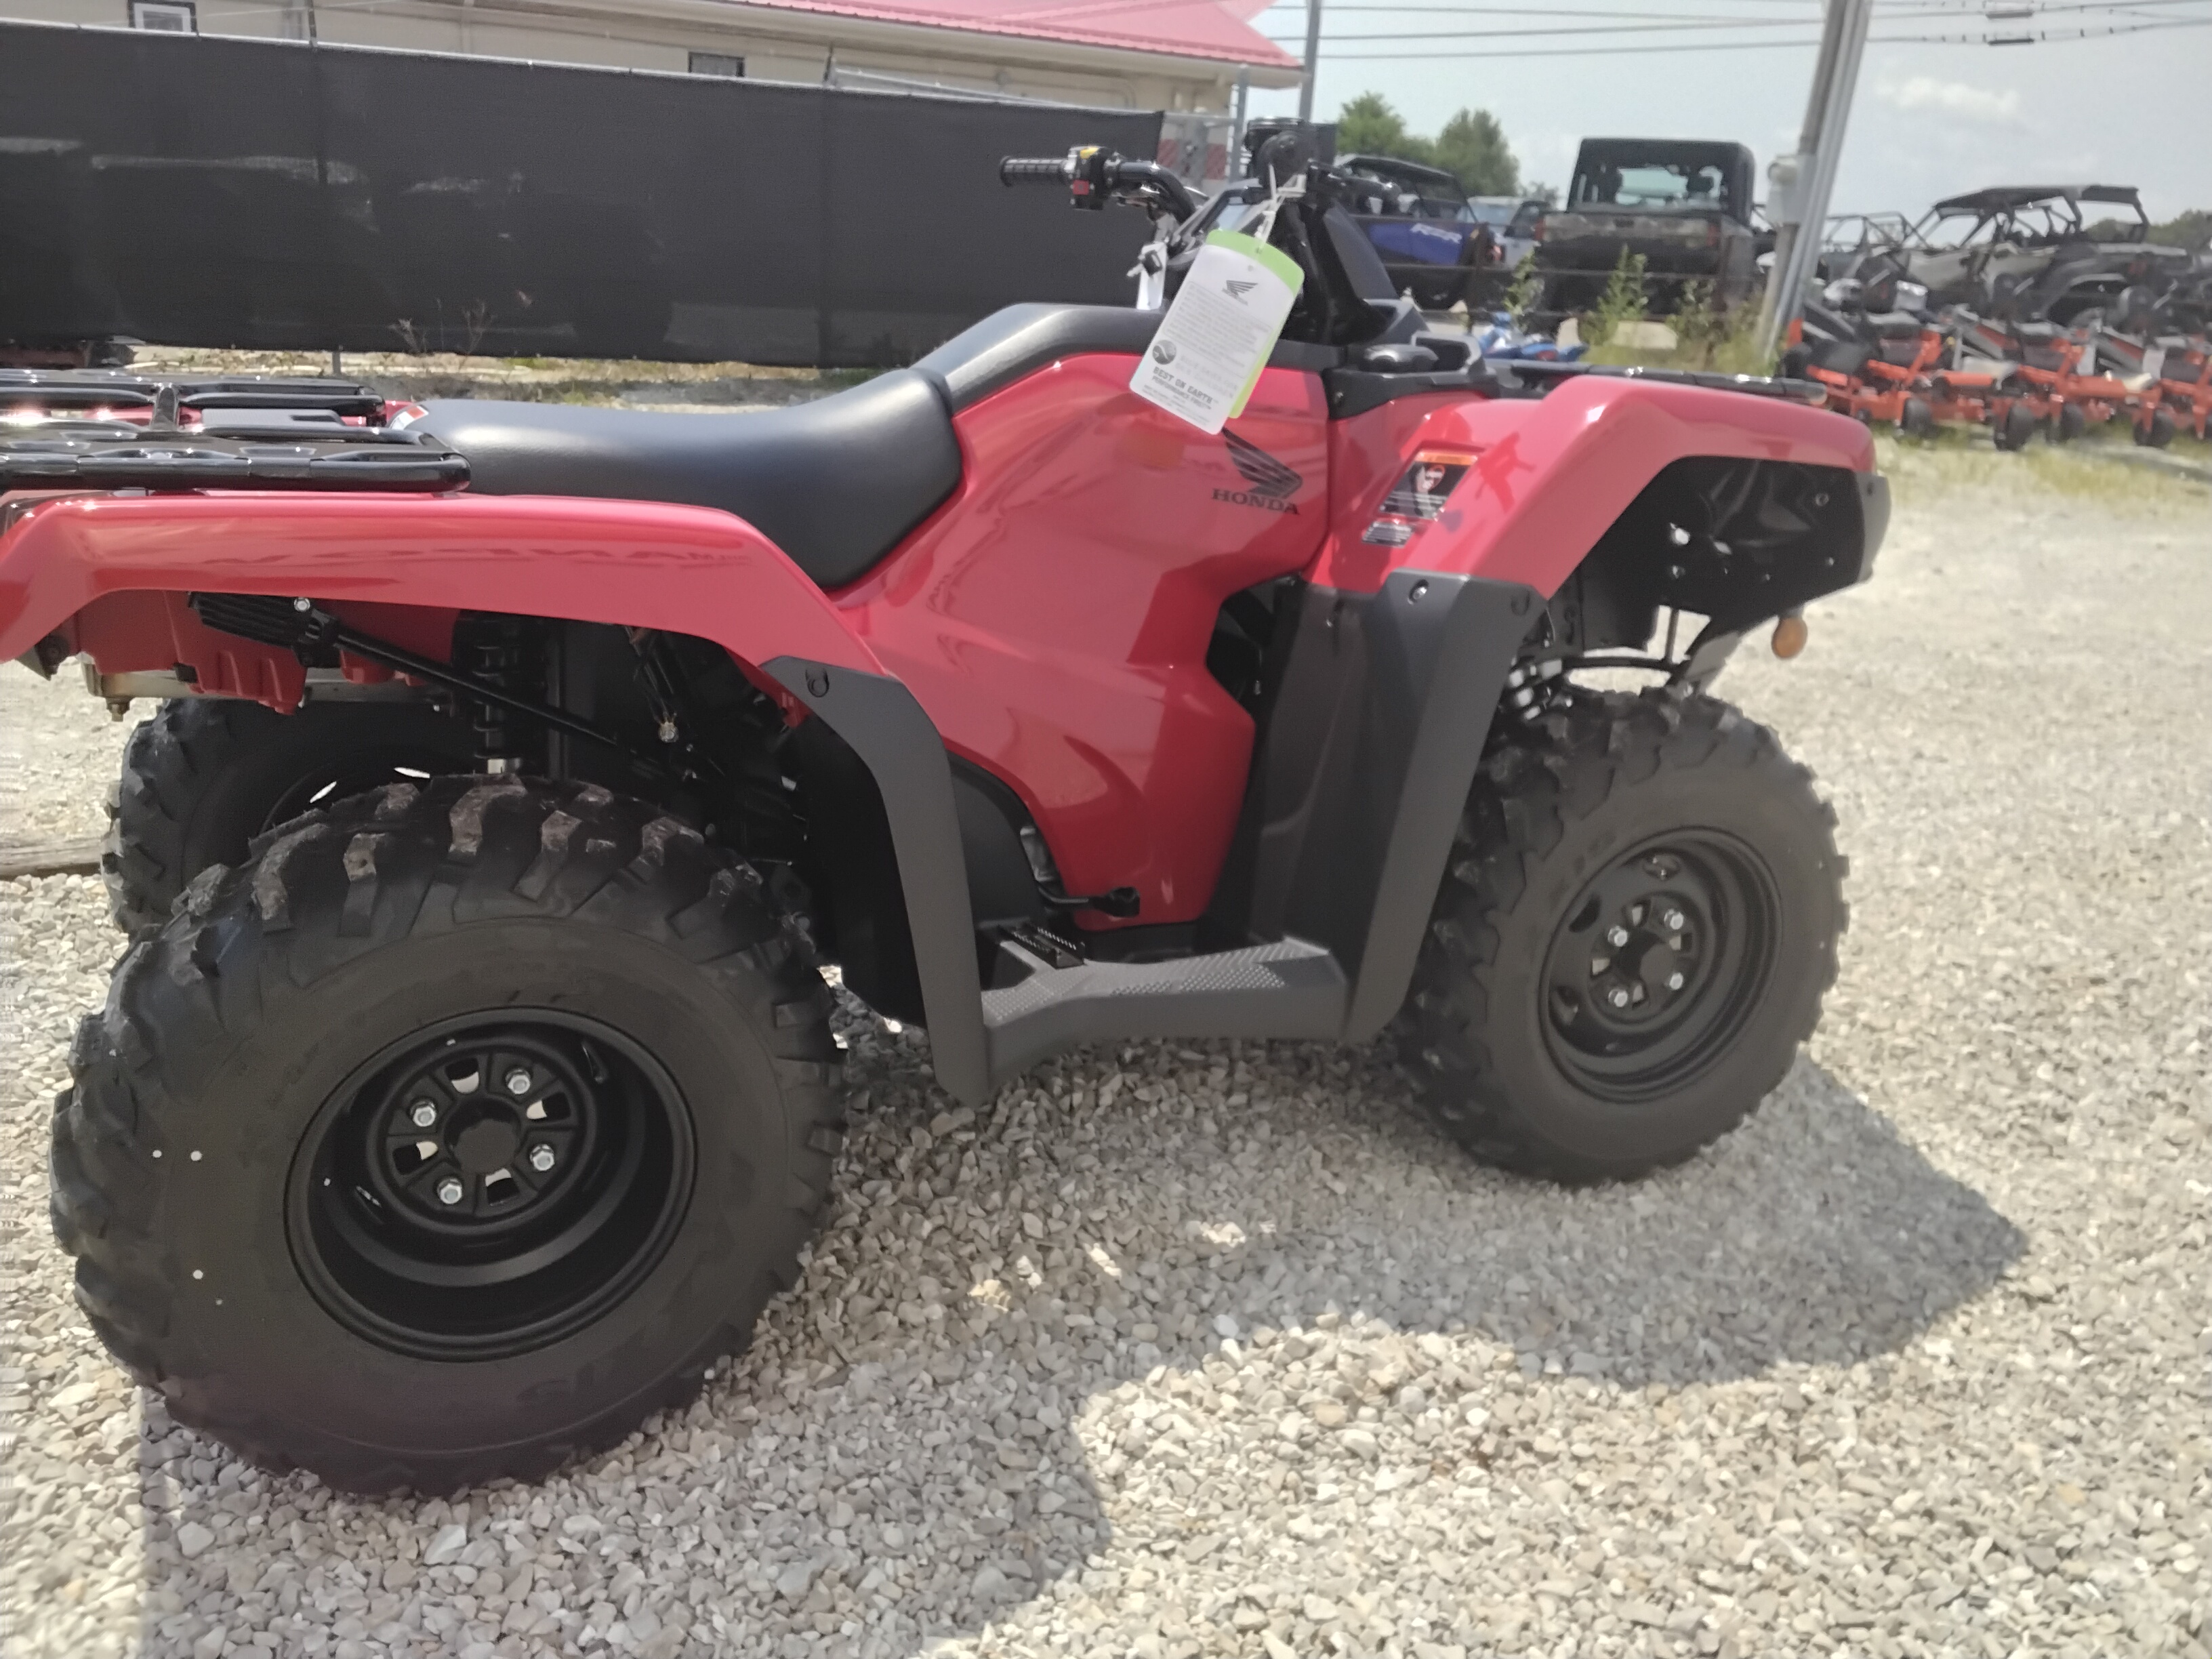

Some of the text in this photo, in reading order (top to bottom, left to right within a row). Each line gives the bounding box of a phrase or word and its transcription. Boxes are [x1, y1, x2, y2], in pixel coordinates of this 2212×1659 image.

[1152, 366, 1174, 382] BEST
[1174, 378, 1187, 390] ON
[1187, 385, 1213, 405] EARTH
[1212, 489, 1299, 515] HONDA
